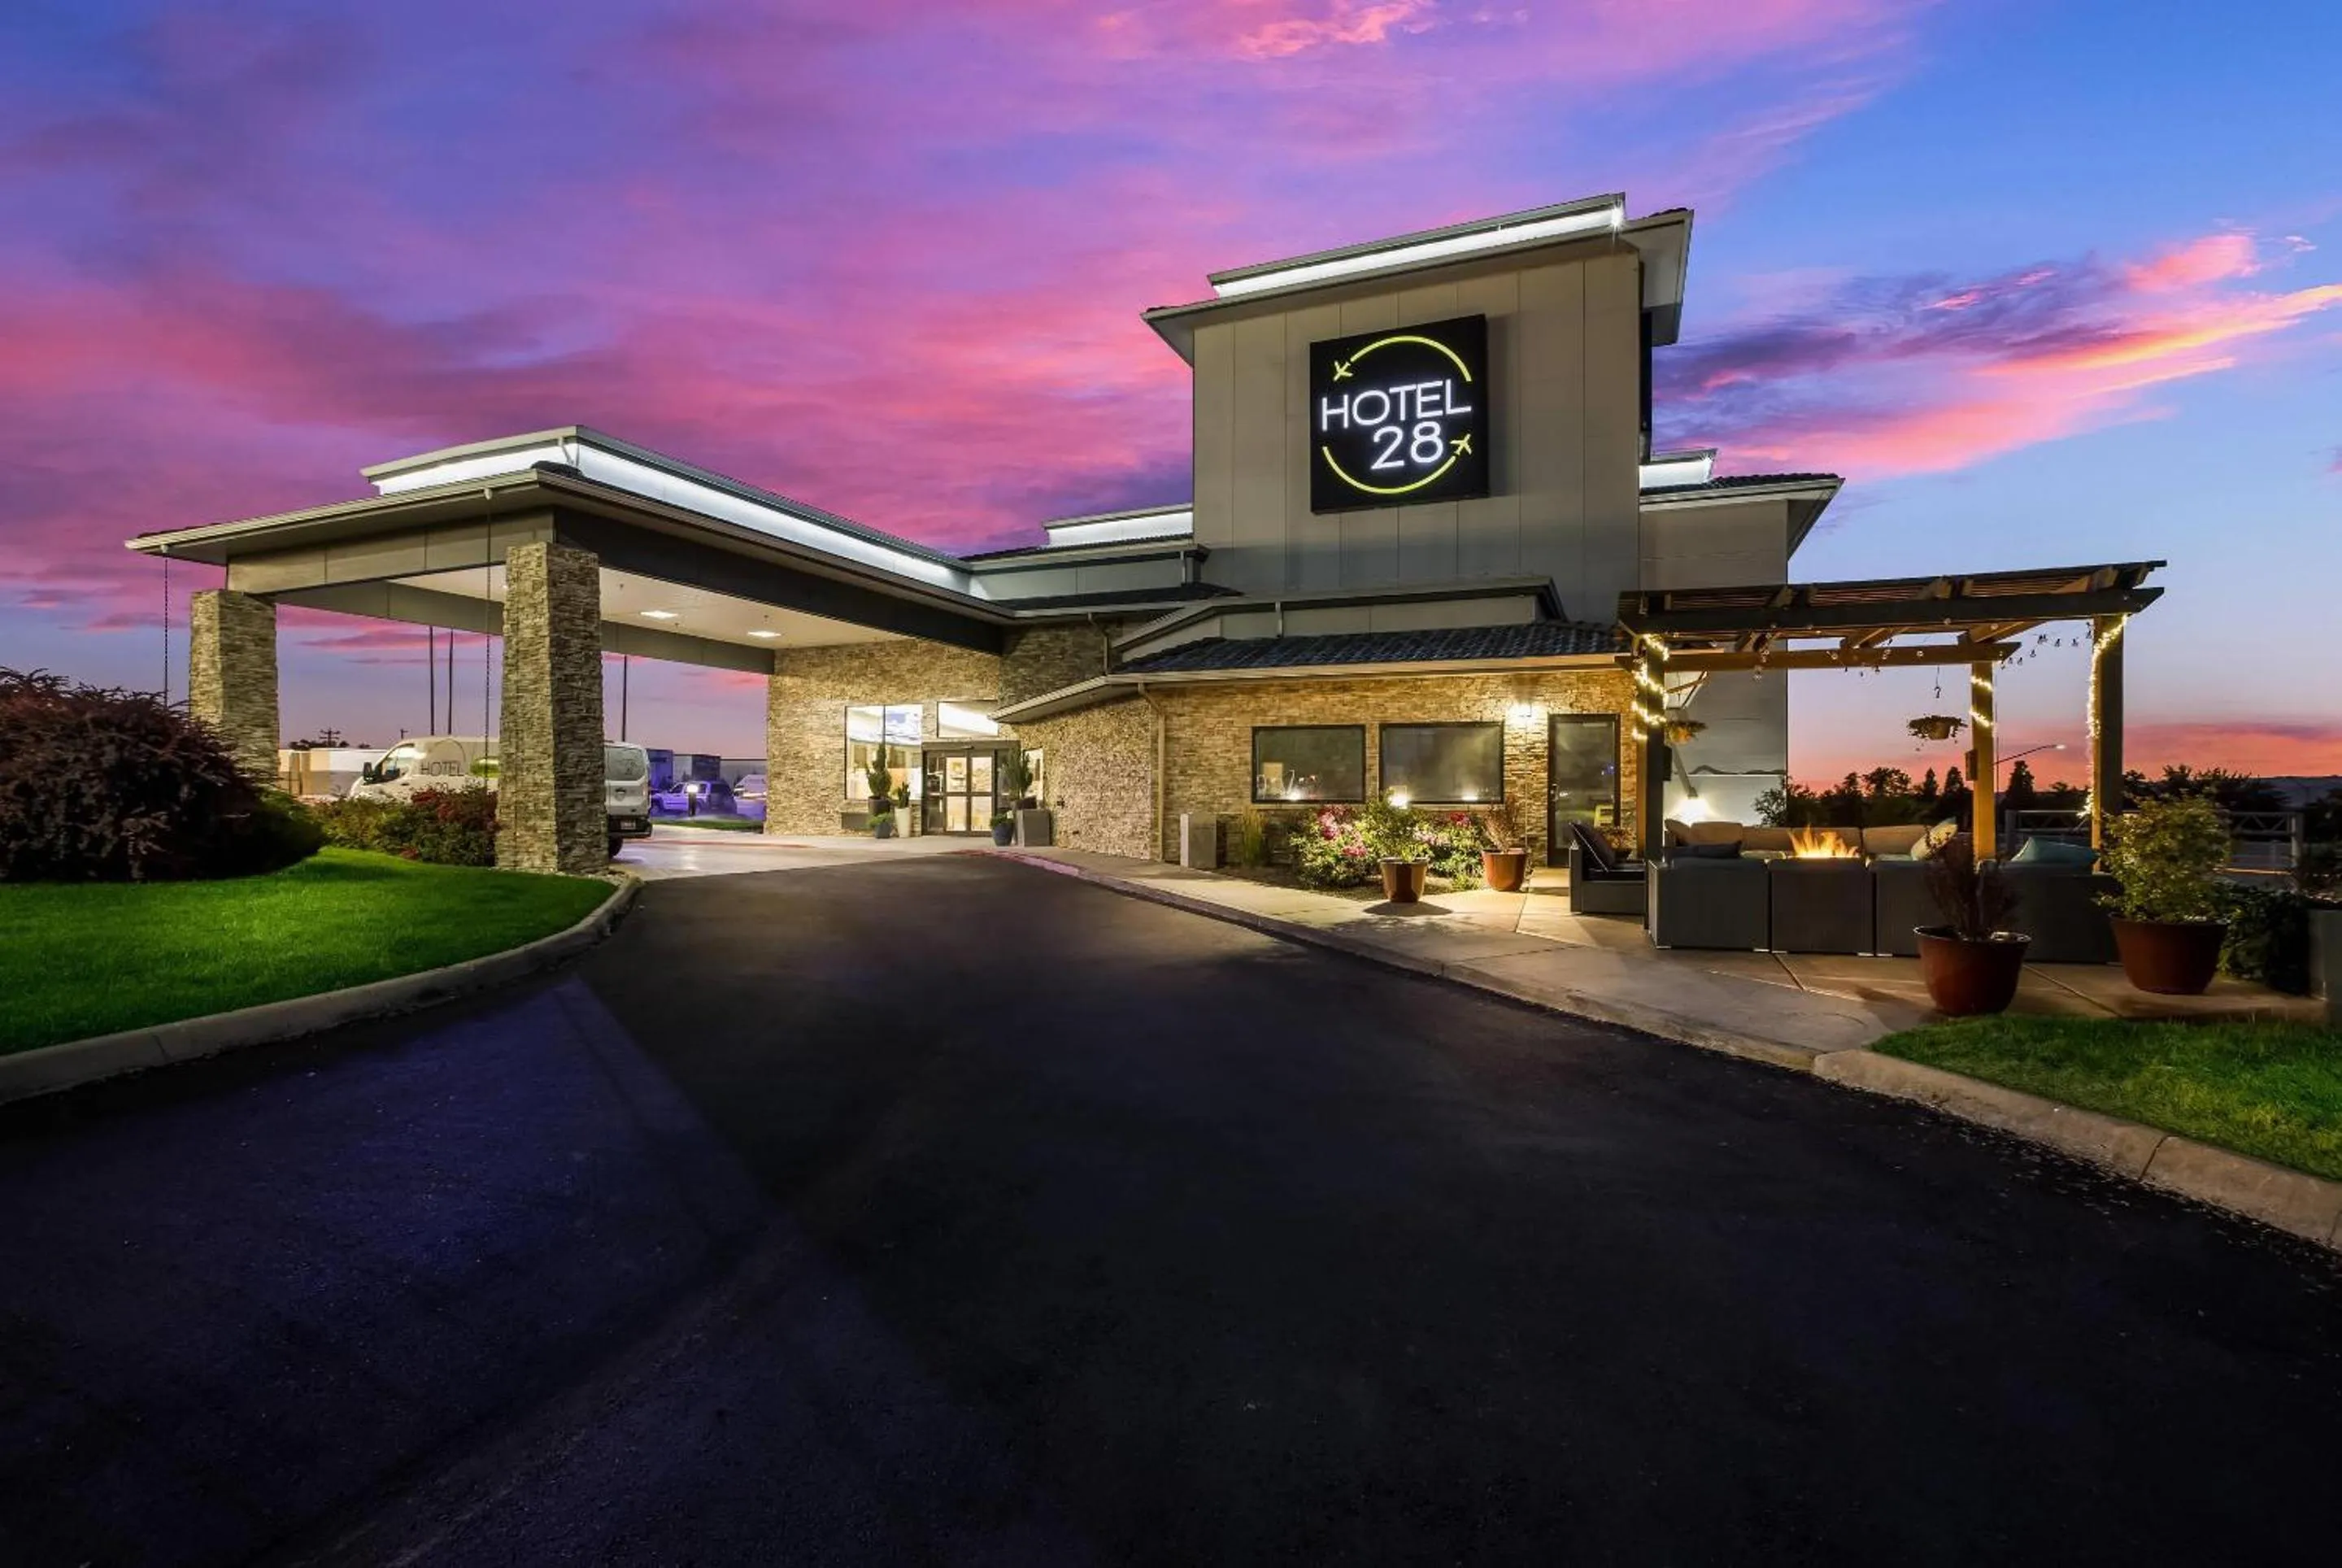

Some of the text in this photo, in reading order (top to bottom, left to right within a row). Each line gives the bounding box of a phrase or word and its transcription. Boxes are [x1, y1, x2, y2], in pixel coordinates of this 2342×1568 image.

[1321, 378, 1472, 432] HOTEL
[1370, 420, 1444, 470] 28
[420, 760, 464, 777] HOTEL
